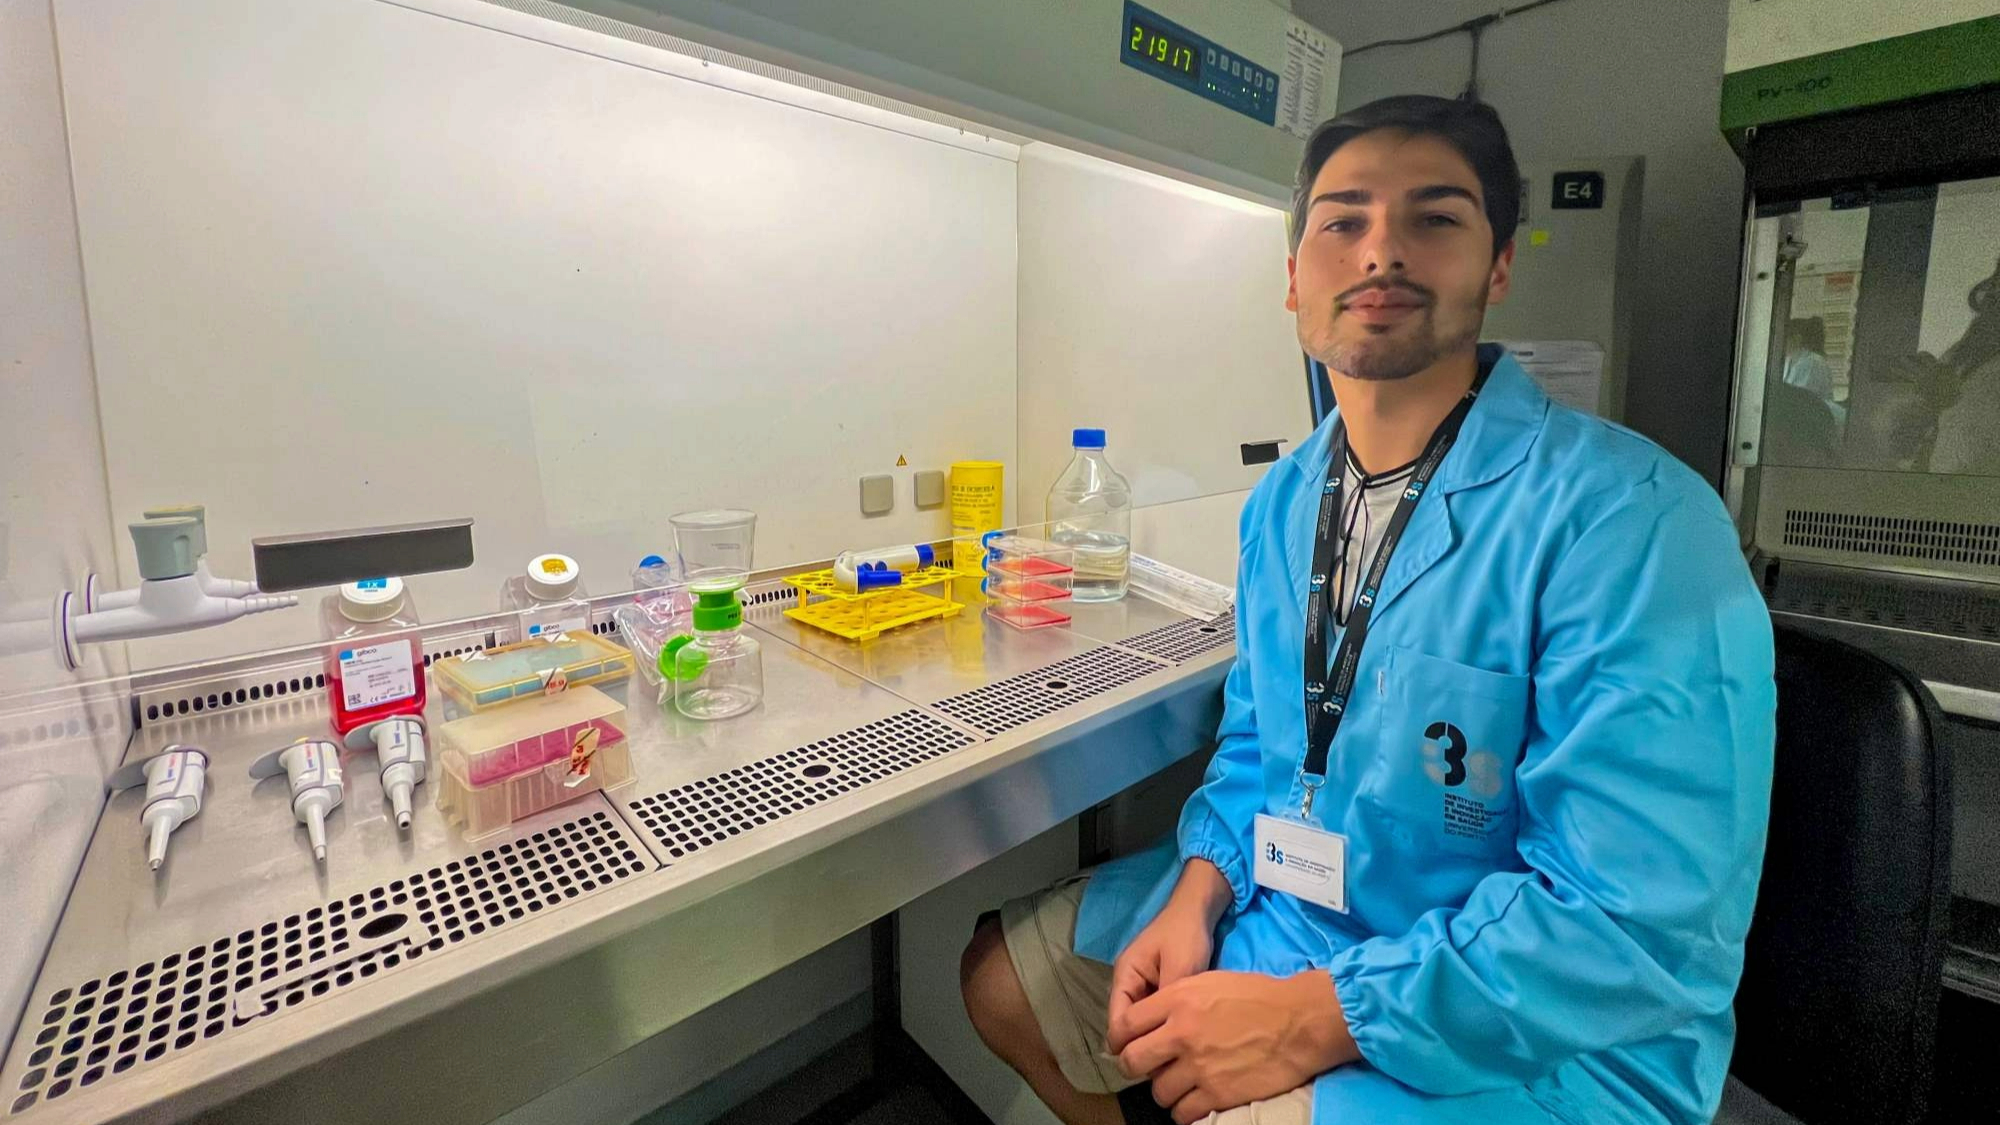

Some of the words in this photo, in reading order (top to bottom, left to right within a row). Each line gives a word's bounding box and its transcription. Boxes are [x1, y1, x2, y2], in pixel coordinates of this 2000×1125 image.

[1563, 181, 1593, 199] E4
[357, 648, 377, 657] gibco
[1444, 793, 1485, 808] INSTITUTO
